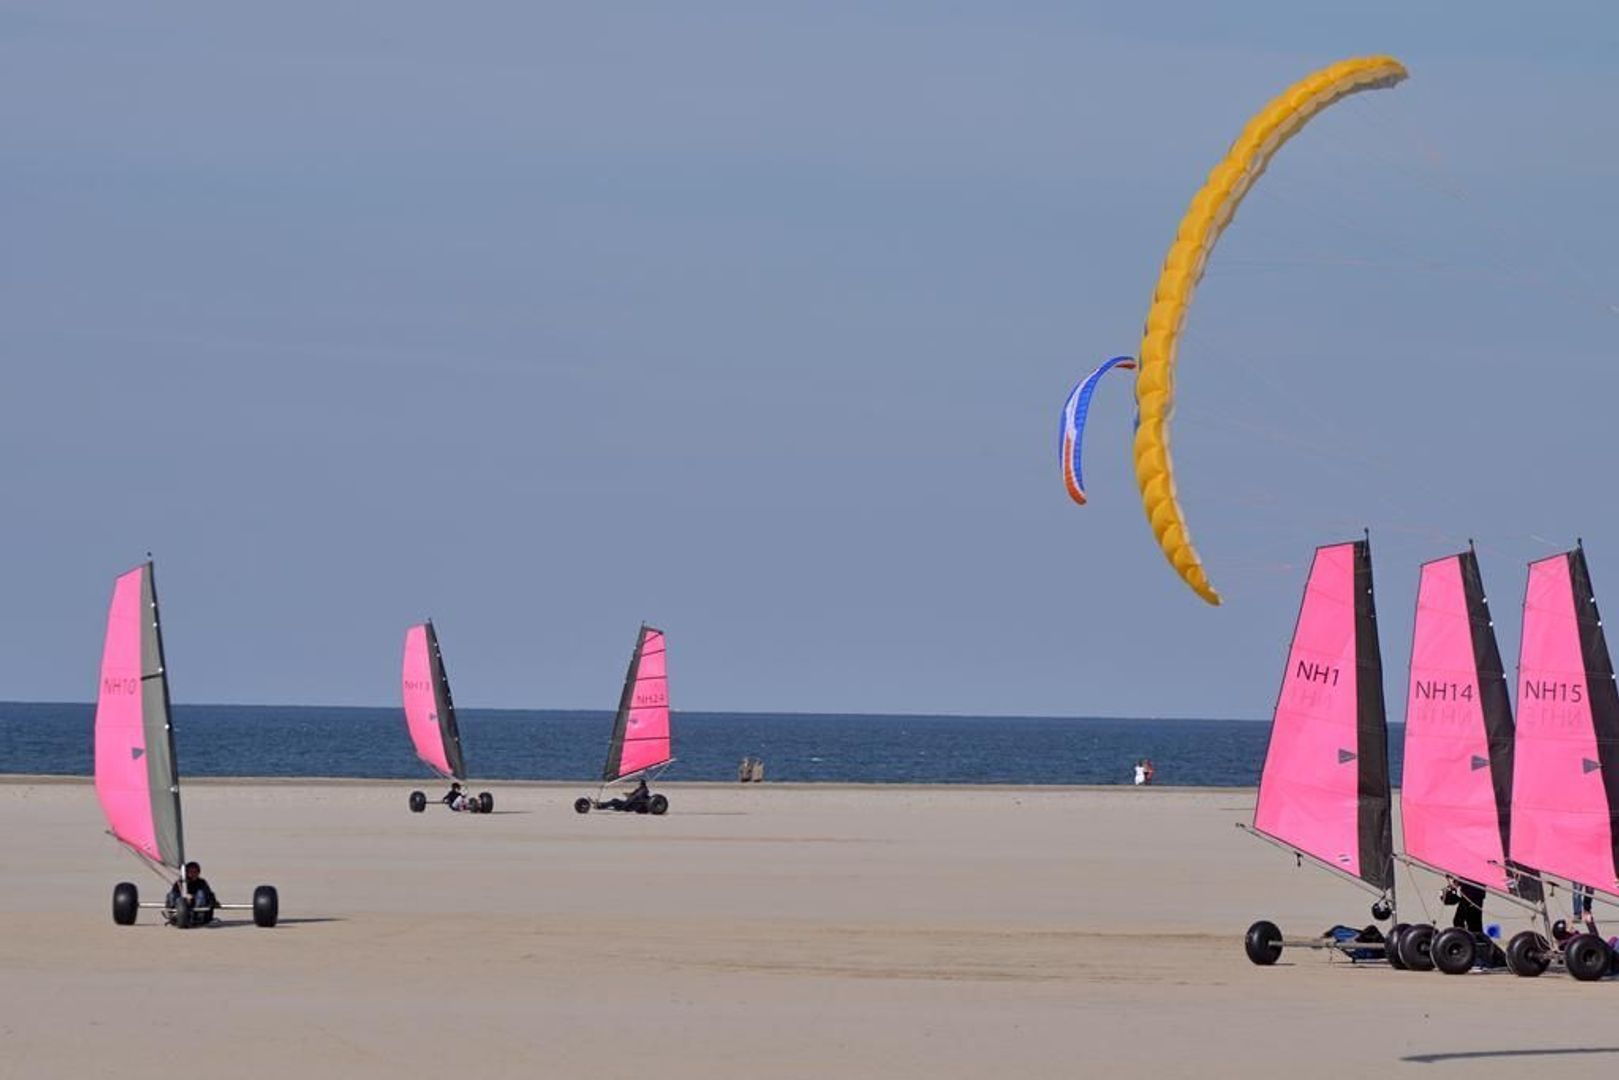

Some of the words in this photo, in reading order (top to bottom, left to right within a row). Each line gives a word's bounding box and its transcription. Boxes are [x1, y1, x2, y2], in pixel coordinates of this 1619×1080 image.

[1296, 660, 1339, 686] NH1
[104, 677, 137, 695] NH10
[1415, 680, 1473, 702] NH14
[1524, 680, 1582, 703] NH15
